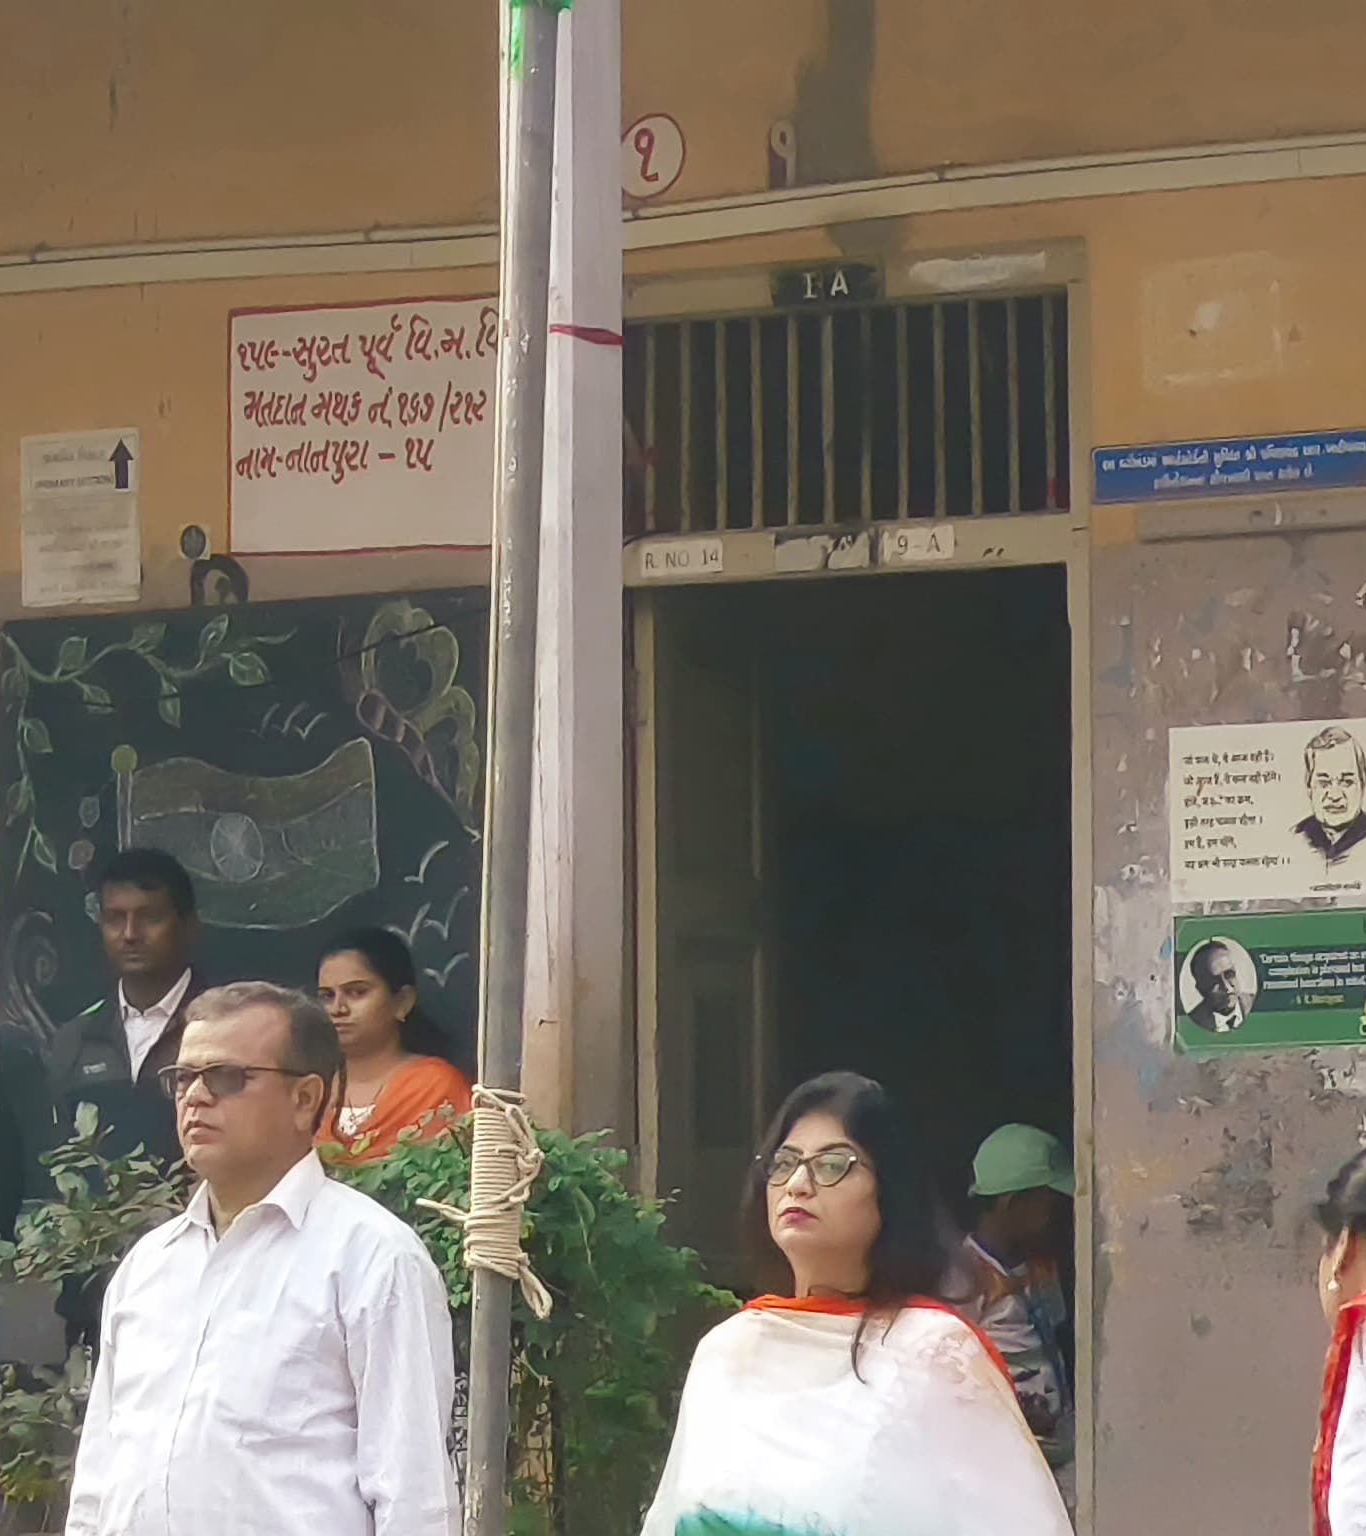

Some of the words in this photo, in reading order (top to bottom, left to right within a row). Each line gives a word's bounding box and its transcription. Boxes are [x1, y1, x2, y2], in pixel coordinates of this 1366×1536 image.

[830, 269, 849, 297] A
[243, 390, 307, 428] મતદાન
[310, 390, 362, 427] મથક
[665, 550, 690, 569] NO
